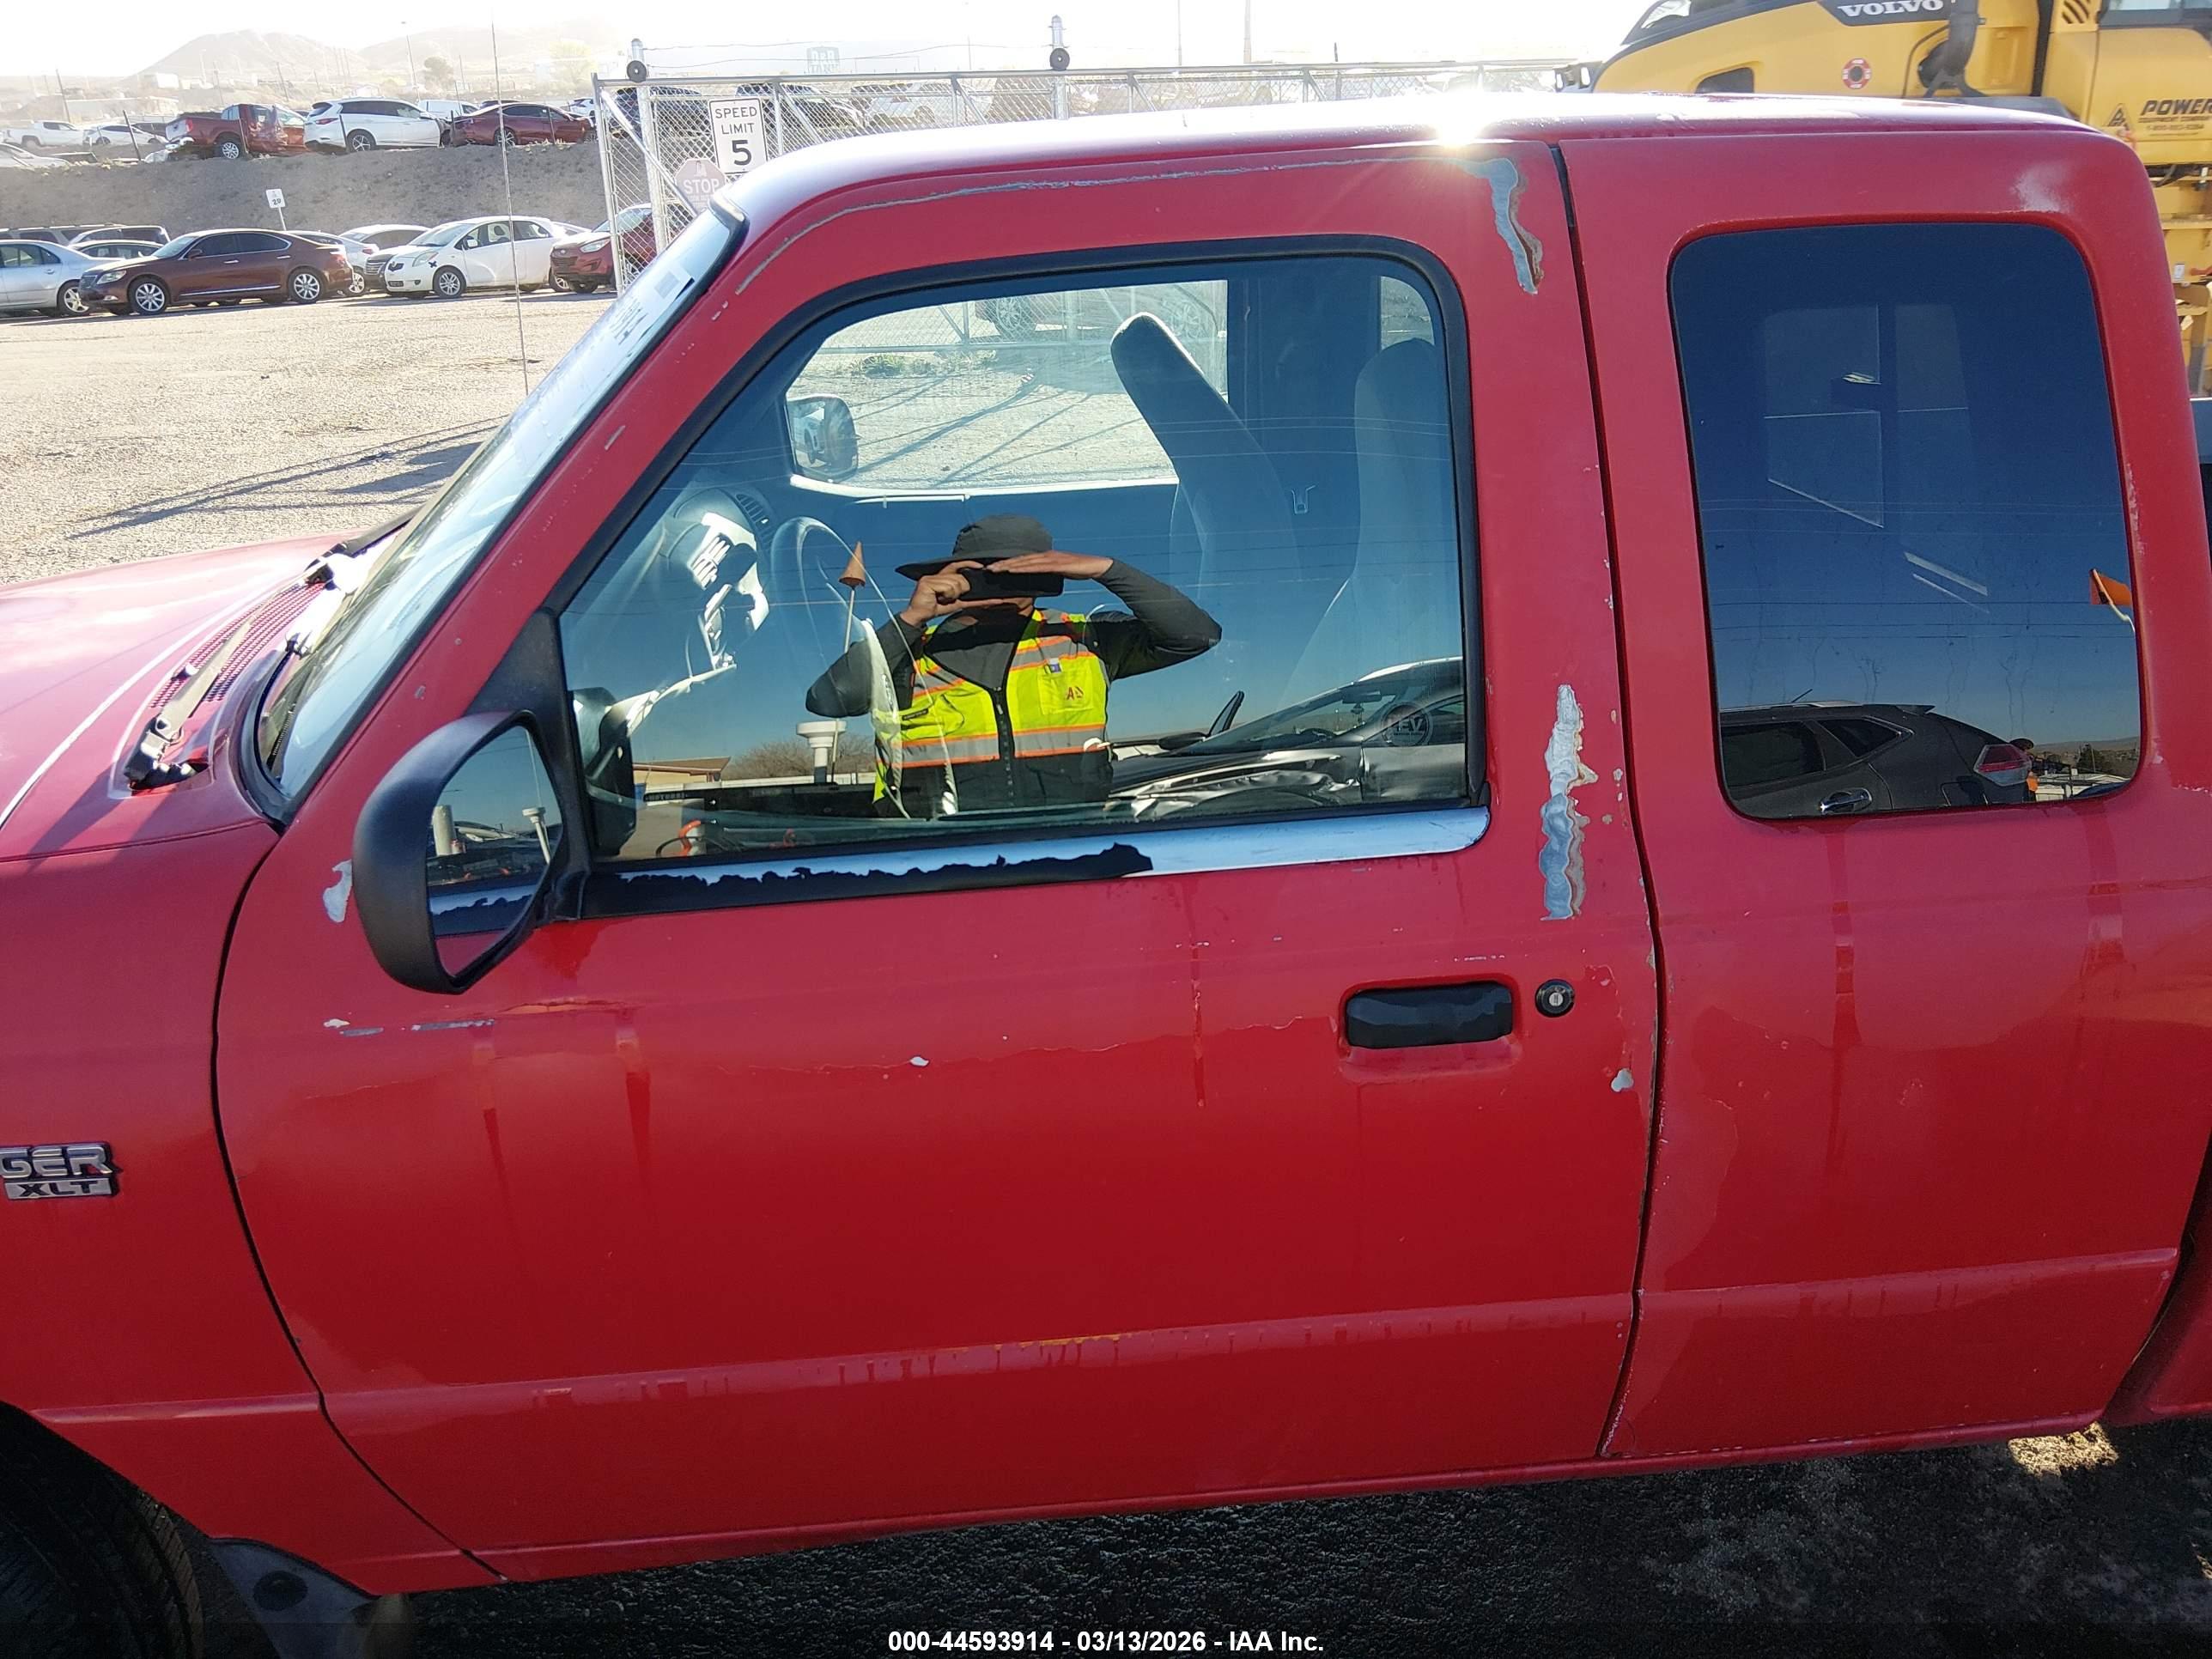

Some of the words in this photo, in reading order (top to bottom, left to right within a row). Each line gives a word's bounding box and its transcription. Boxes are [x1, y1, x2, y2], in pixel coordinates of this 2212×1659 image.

[1838, 0, 1944, 17] VOLVO
[714, 106, 757, 118] SPEED
[720, 123, 755, 135] LIMIT
[731, 139, 752, 166] 5
[683, 178, 720, 194] STOP
[0, 1144, 112, 1179] GER
[17, 1180, 99, 1197] XLT
